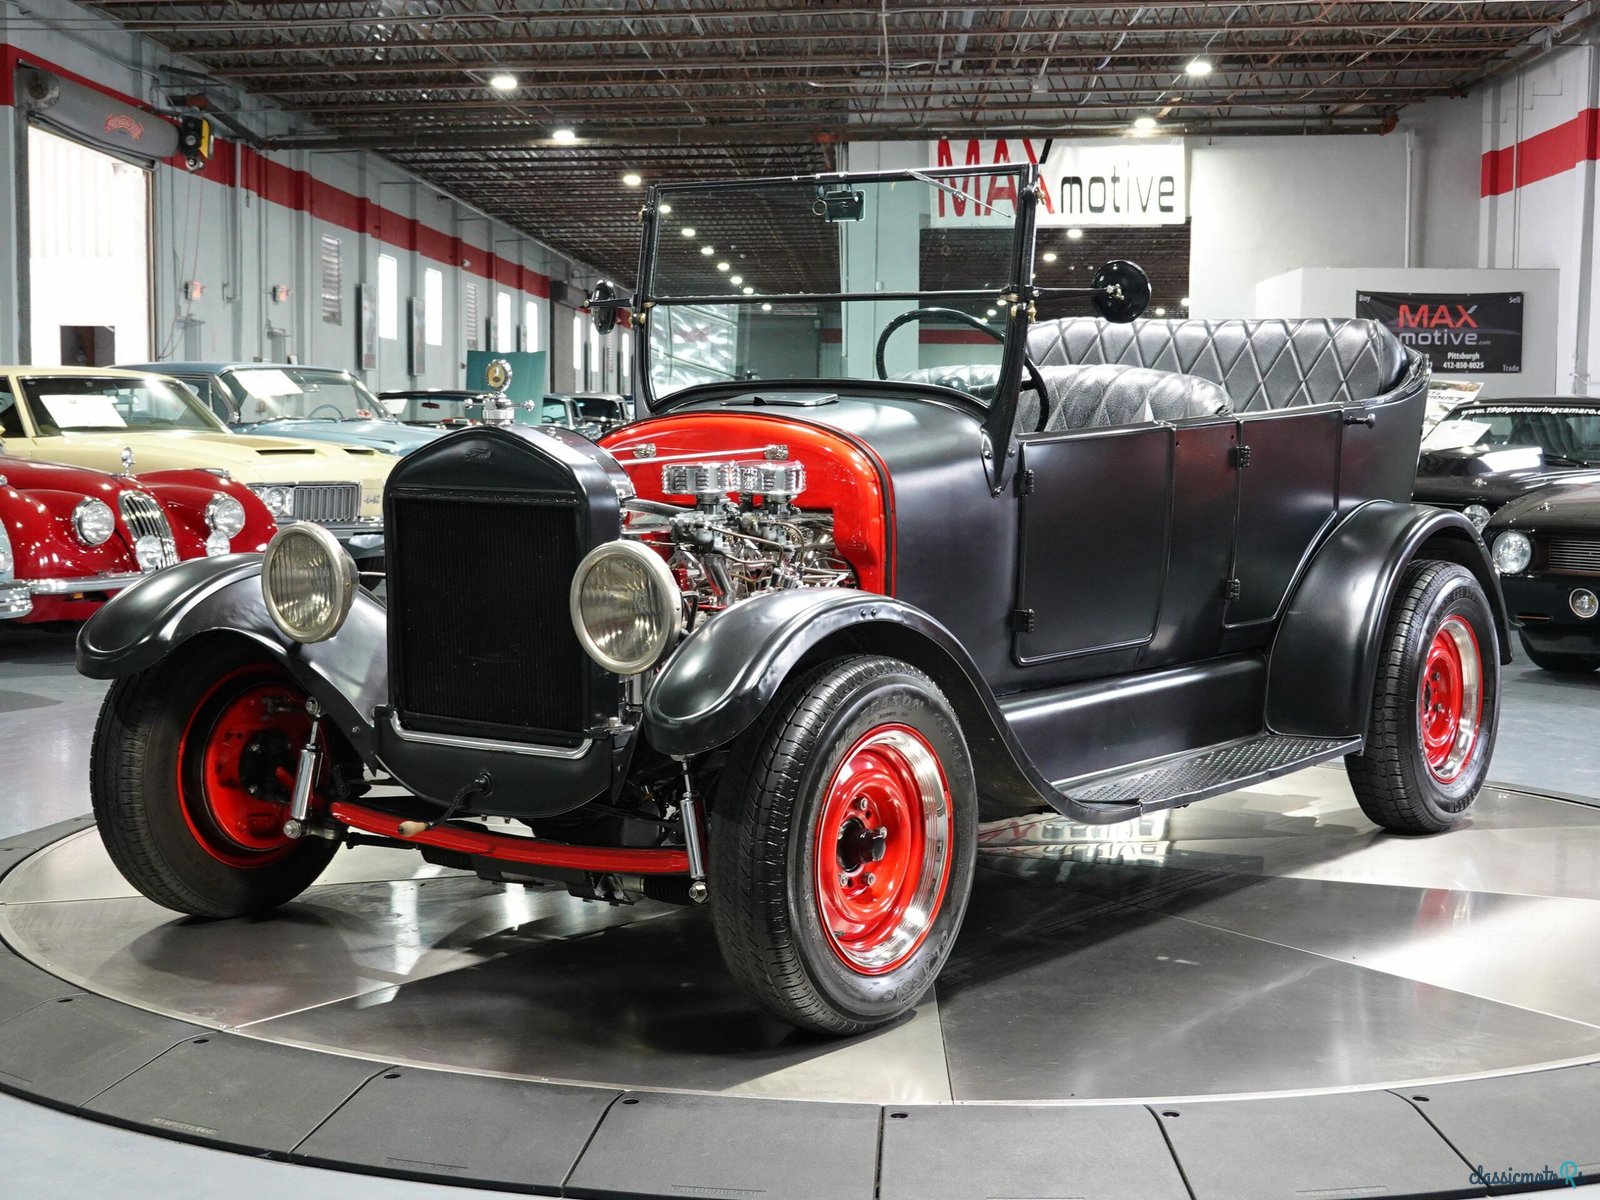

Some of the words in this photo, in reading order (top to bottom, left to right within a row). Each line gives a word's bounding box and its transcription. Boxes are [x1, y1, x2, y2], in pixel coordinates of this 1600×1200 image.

[937, 138, 1055, 217] MAX
[1060, 162, 1175, 214] motive
[1358, 295, 1372, 303] Buy
[1508, 296, 1521, 304] Sell
[1398, 304, 1479, 328] MAX
[1447, 352, 1480, 361] Pittsburgh
[1502, 364, 1520, 372] Trade
